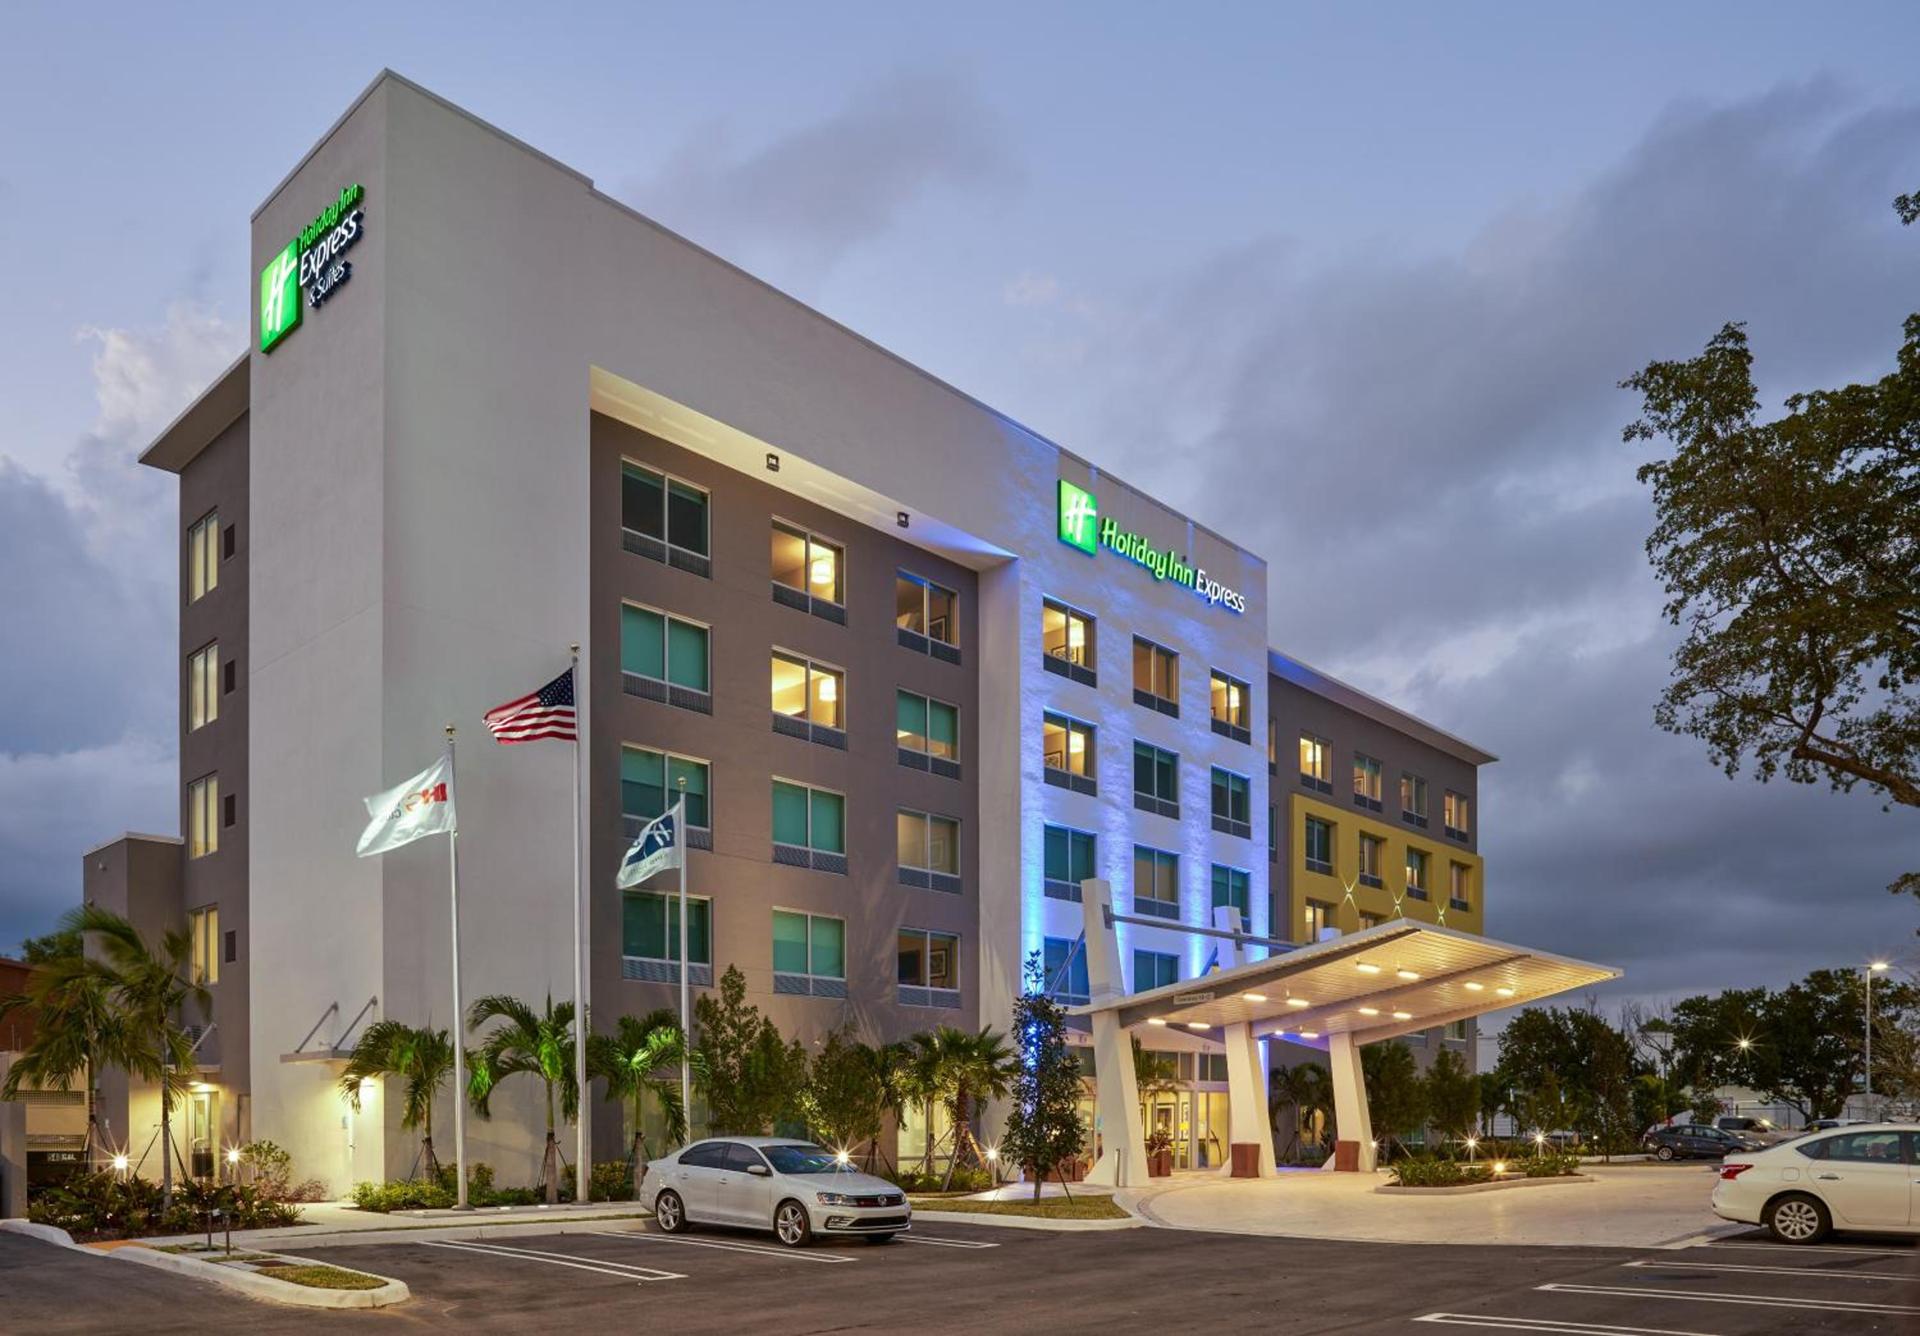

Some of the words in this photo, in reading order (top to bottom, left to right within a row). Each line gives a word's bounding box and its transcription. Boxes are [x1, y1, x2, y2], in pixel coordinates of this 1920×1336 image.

[300, 210, 358, 287] Express
[301, 203, 339, 250] Holiday
[340, 184, 359, 212] Inn
[316, 260, 345, 299] Suites
[1102, 517, 1167, 580] Holiday
[1169, 551, 1193, 587] Inn
[1196, 568, 1246, 613] Express
